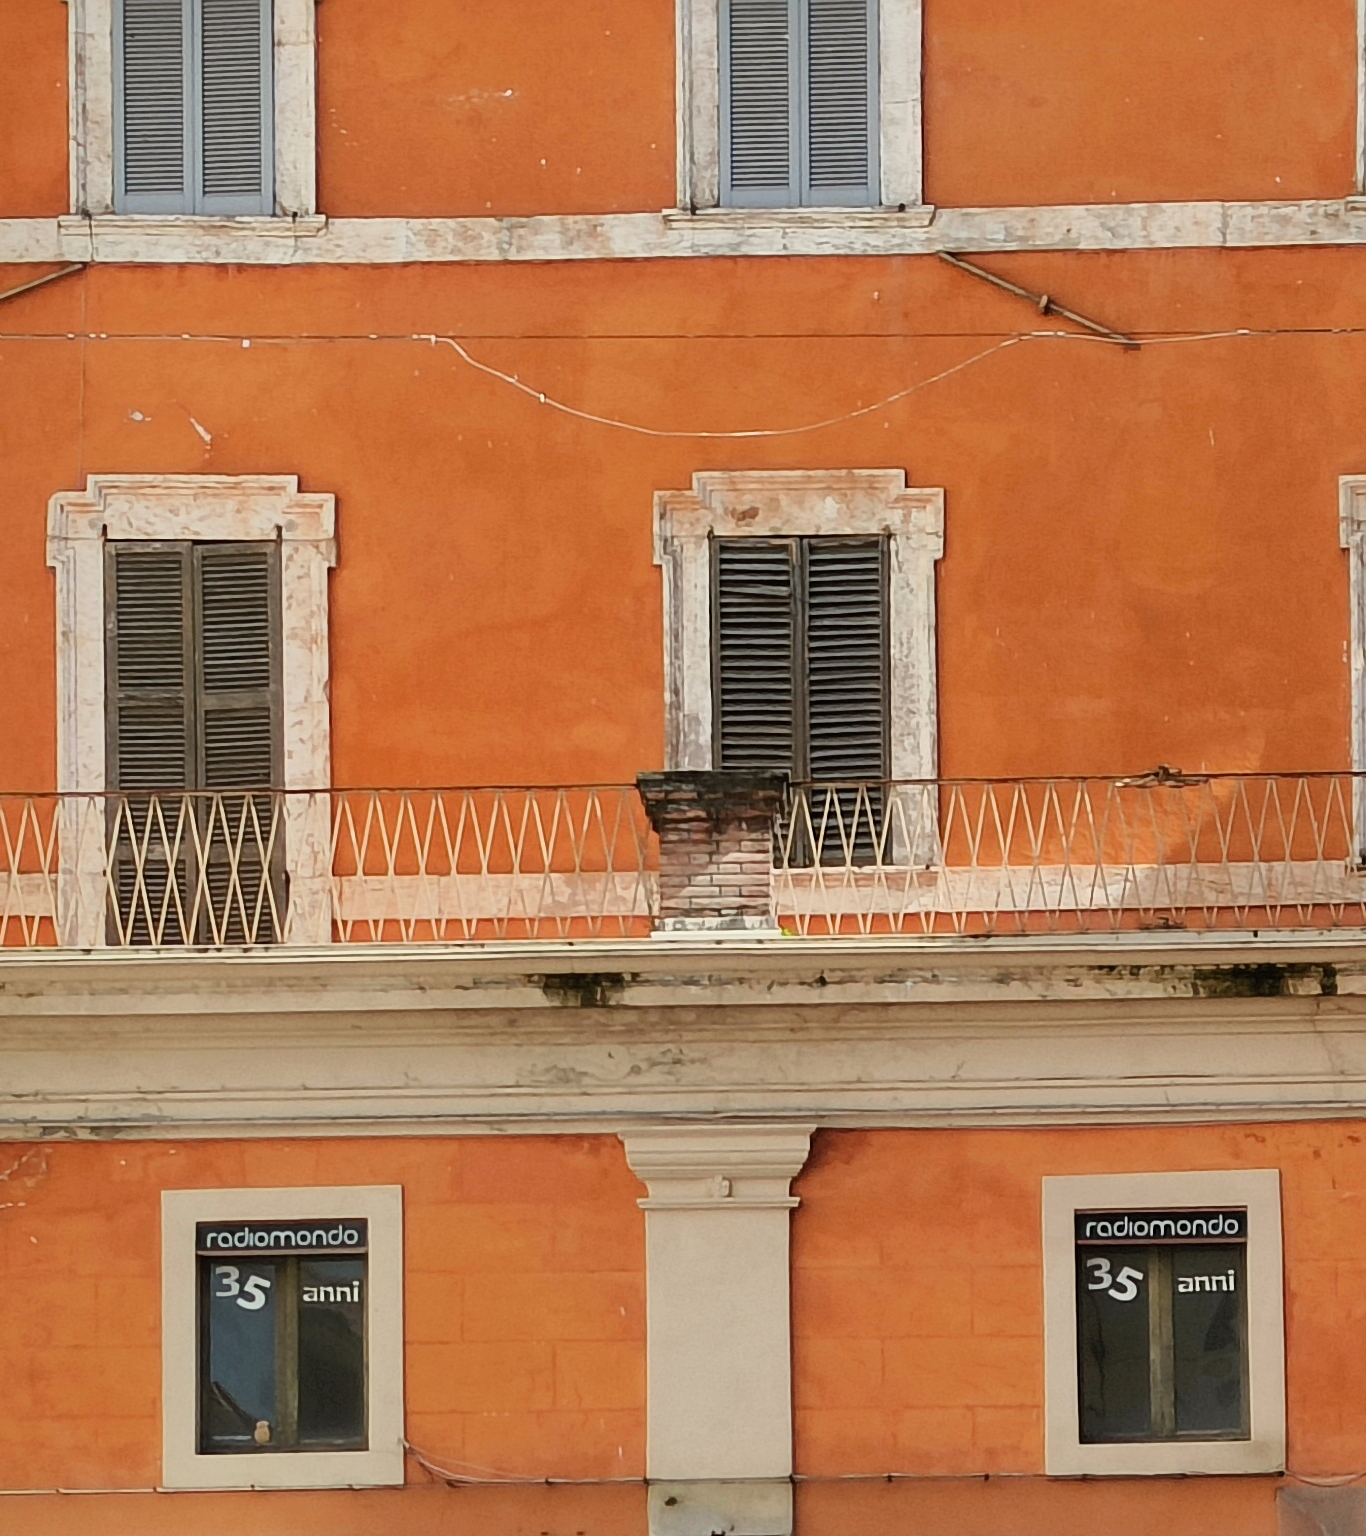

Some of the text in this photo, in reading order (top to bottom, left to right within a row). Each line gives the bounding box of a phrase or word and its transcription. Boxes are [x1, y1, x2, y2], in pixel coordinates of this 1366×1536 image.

[207, 1224, 358, 1248] radiomondo
[1086, 1214, 1239, 1237] radiomondo
[215, 1265, 360, 1310] 35 anni
[1086, 1257, 1235, 1301] 35 anni
